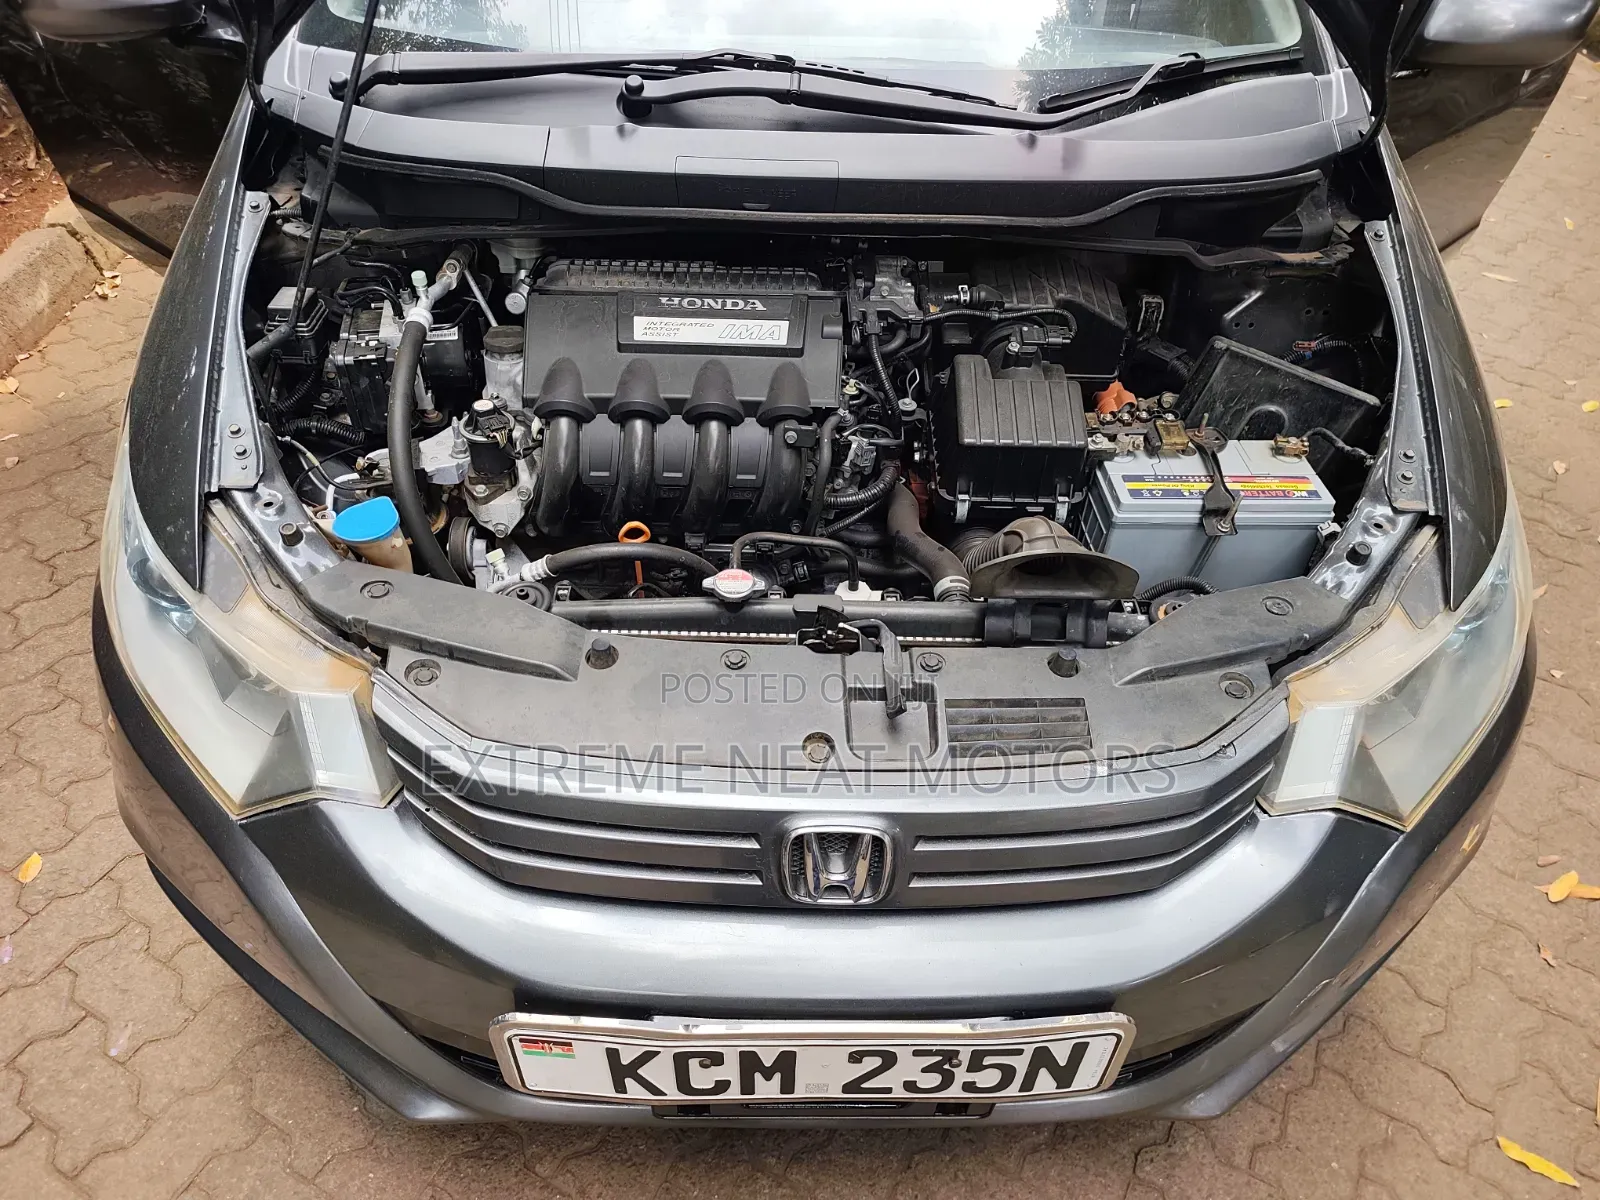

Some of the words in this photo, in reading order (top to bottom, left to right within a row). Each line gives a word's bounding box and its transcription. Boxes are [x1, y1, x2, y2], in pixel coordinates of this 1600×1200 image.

[658, 297, 767, 311] HONDA
[718, 323, 781, 340] IMA
[605, 1047, 797, 1096] KCM
[841, 1041, 1090, 1095] 235N
